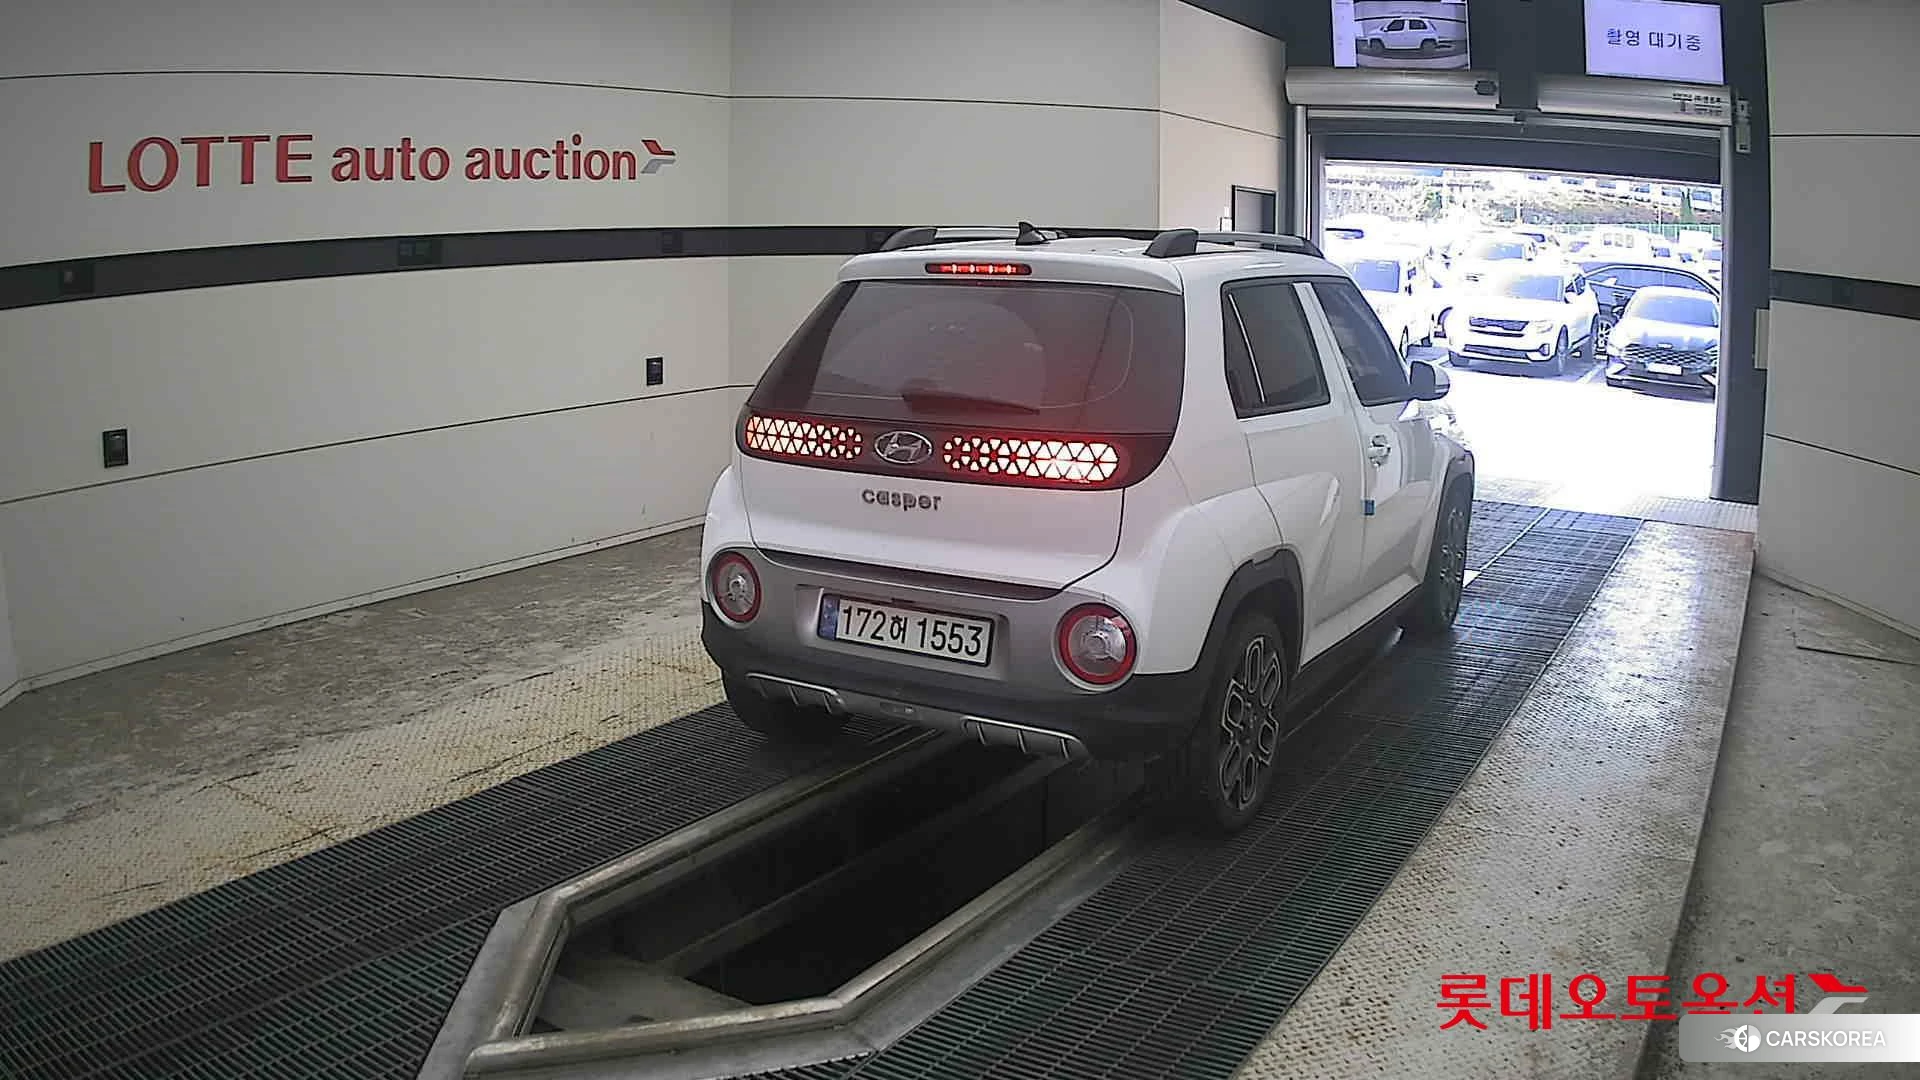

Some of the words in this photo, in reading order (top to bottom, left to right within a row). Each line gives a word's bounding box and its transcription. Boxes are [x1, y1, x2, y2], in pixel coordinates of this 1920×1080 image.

[1648, 31, 1701, 52] 대기중
[88, 134, 313, 194] LOTTE
[331, 137, 450, 181] auto
[464, 133, 637, 182] auction
[862, 488, 942, 511] casper
[843, 605, 908, 644] 172허
[917, 617, 983, 657] 1553
